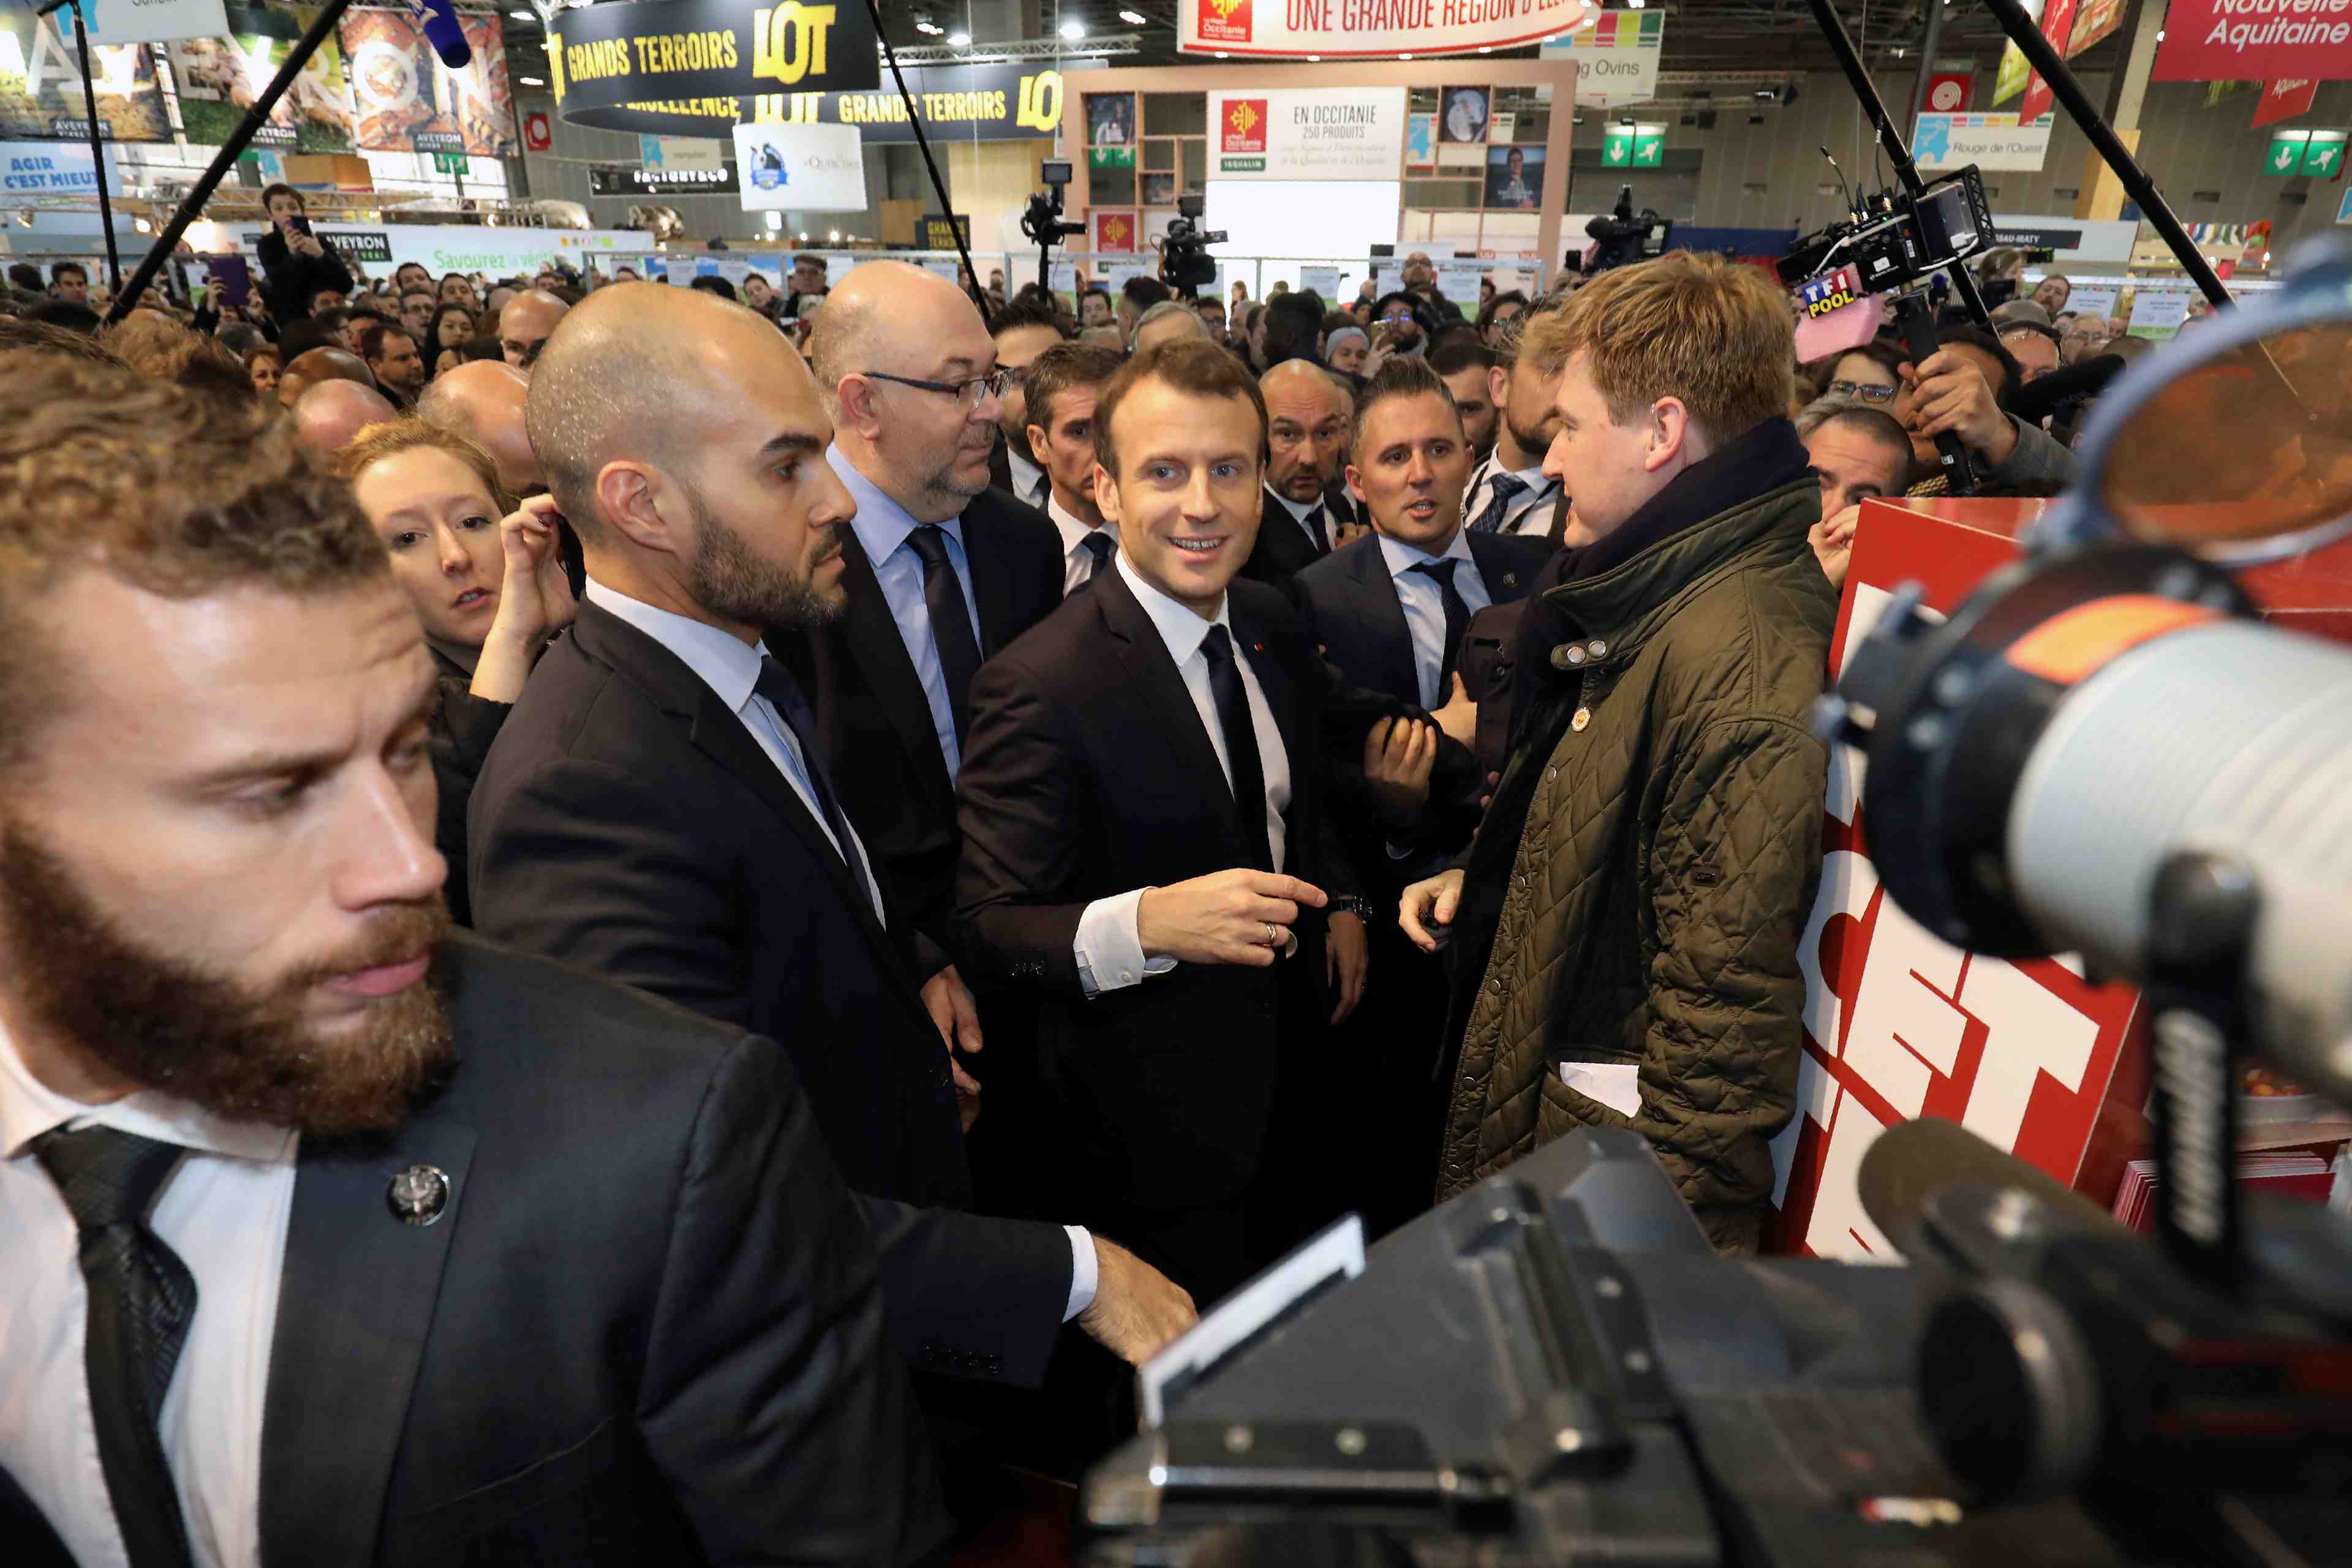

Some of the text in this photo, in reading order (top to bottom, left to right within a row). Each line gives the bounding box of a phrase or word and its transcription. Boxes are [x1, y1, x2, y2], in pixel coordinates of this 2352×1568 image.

[1286, 0, 1333, 31] UNE
[1342, 0, 1434, 31] GRANDE
[753, 0, 836, 85] LOT
[2205, 16, 2350, 53] Aquitaine
[567, 38, 631, 82] GRANDS
[634, 29, 738, 74] TERROIRS
[1596, 59, 1640, 75] Ovins
[922, 90, 1006, 122] TERROIRS
[1294, 105, 1377, 124] EN OCCITANIE
[1303, 125, 1365, 139] 250 PRODUITS
[1952, 140, 2044, 155] Rouge de l'Ouest
[10, 157, 54, 172] AGIR
[5, 174, 46, 189] C'EST
[433, 247, 506, 271] Savourez
[1808, 290, 1855, 318] POOL
